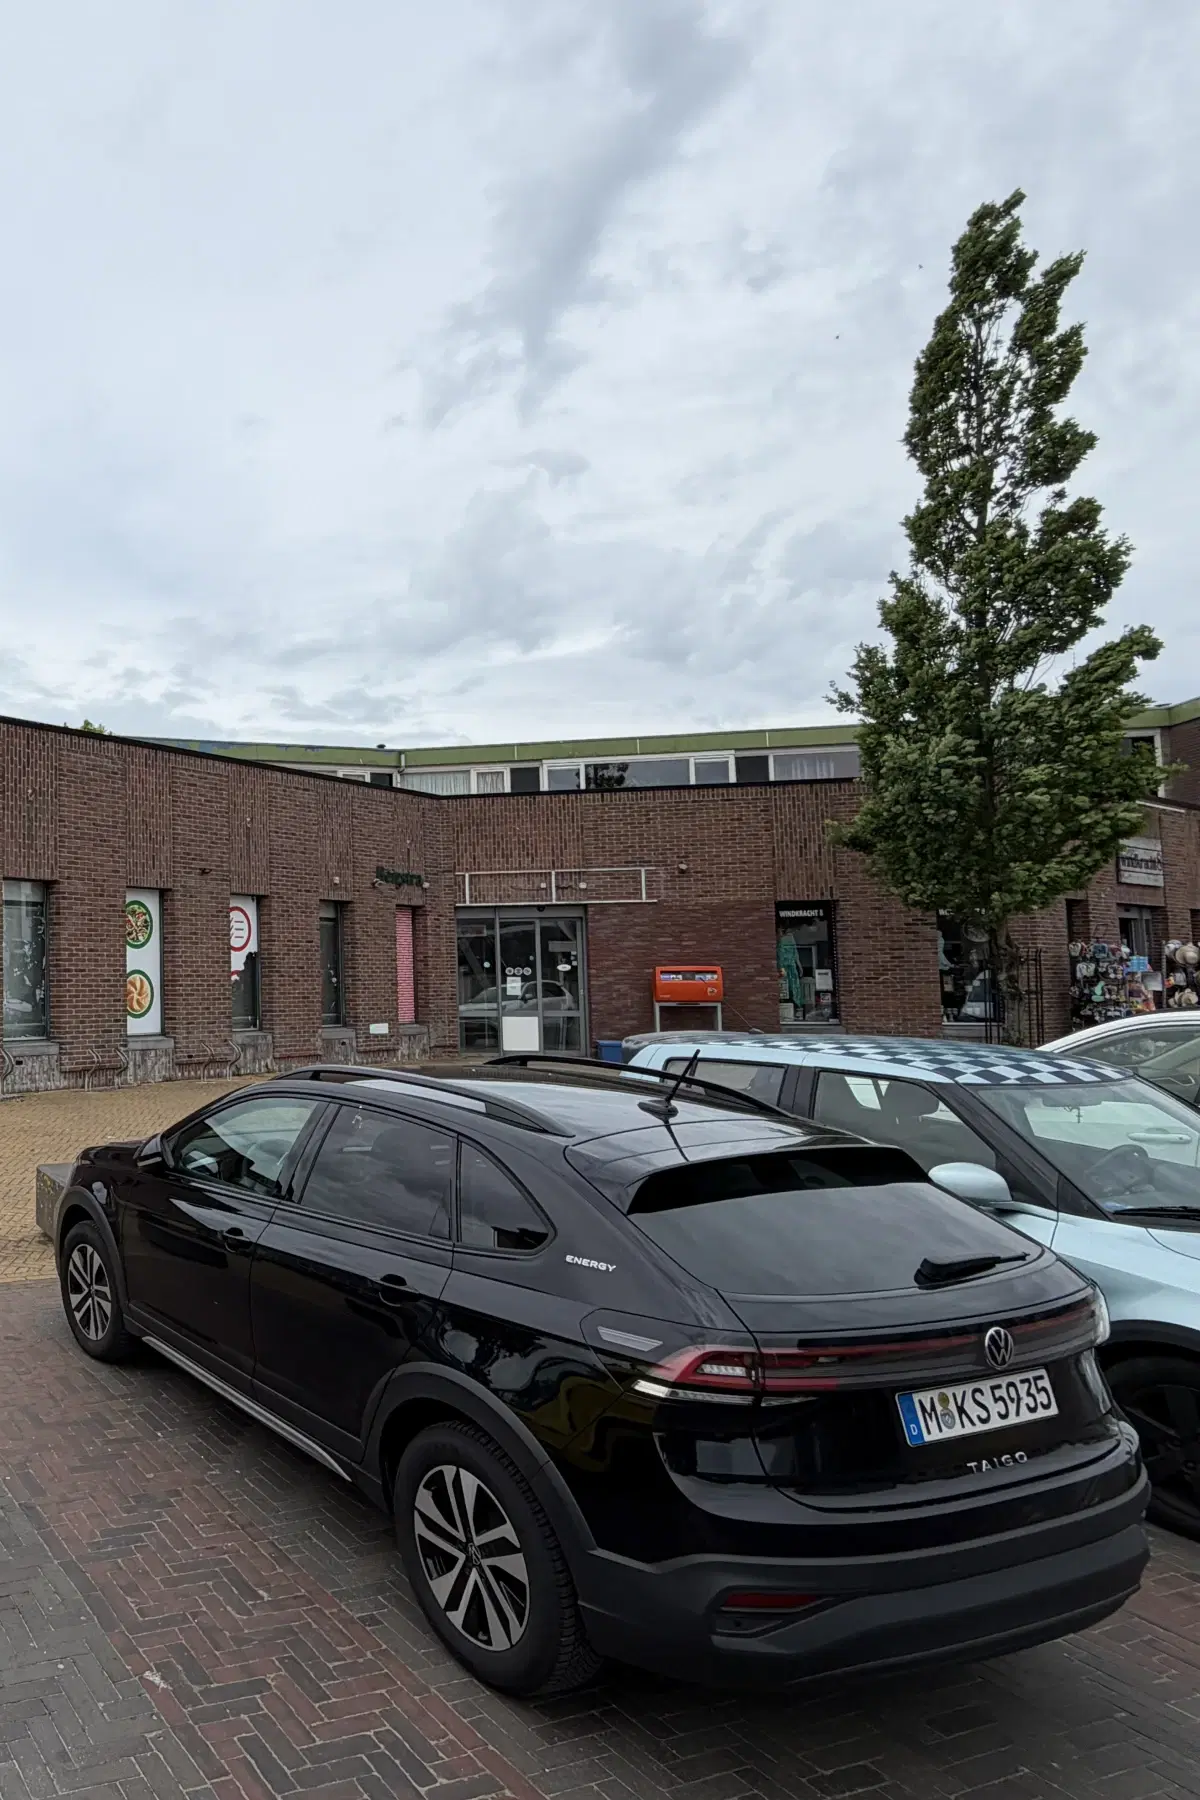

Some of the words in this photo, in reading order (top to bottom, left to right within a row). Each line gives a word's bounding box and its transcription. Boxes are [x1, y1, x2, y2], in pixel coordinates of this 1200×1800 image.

[779, 910, 818, 918] WINDKRACHT
[565, 1254, 617, 1272] ENERGY
[918, 1396, 943, 1436] M
[990, 1374, 1052, 1420] 5935
[910, 1424, 918, 1436] D
[966, 1451, 1028, 1474] TAIGO
